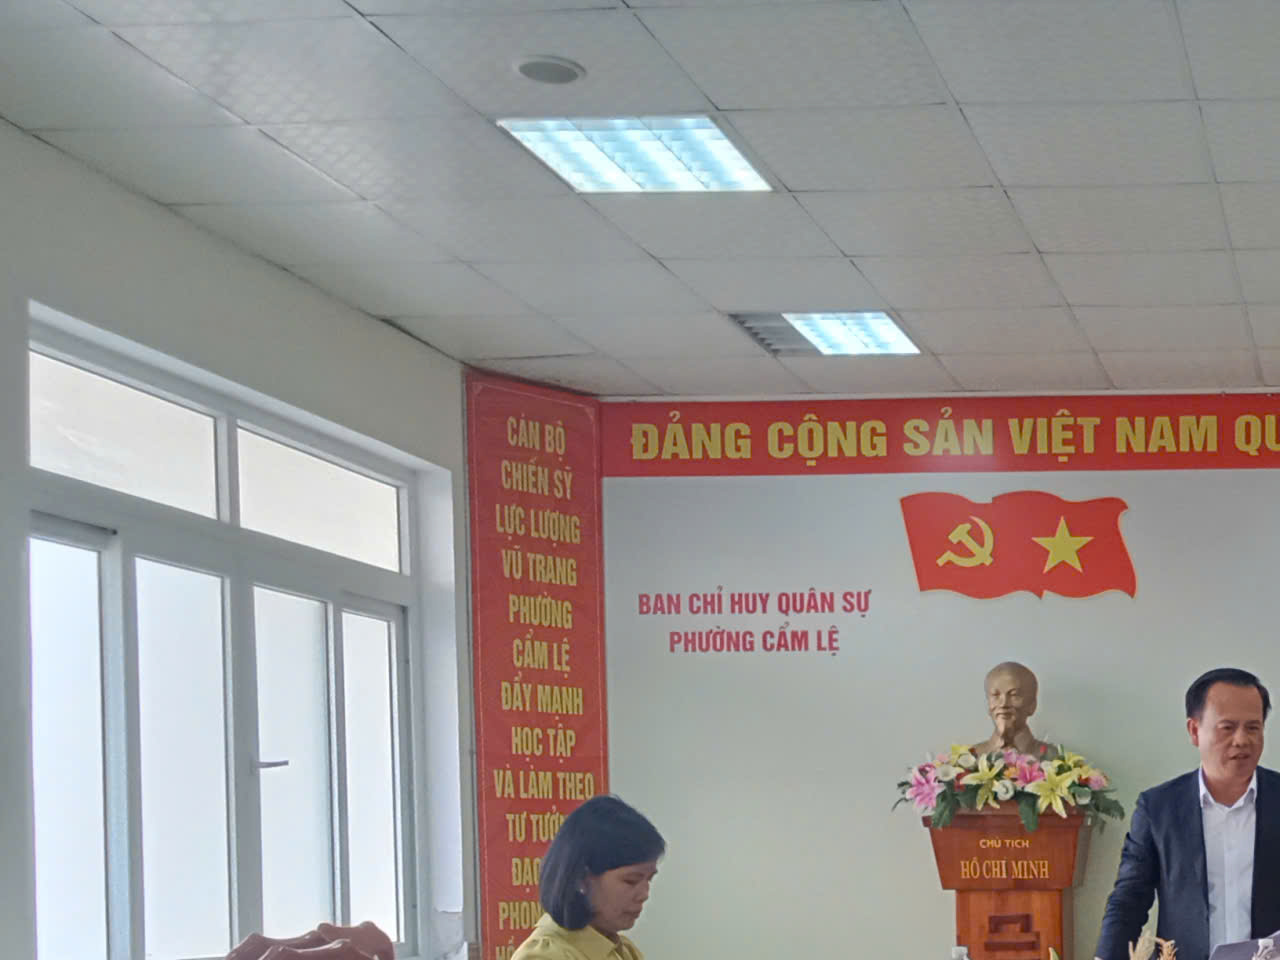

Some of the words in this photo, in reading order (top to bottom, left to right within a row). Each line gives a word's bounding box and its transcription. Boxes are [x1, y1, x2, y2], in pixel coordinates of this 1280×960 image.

[545, 419, 567, 463] BỘ
[631, 411, 752, 460] ĐẢNG
[767, 414, 889, 467] CỘNG
[903, 407, 994, 457] SẢN
[1008, 409, 1101, 463] VIỆT
[1115, 415, 1219, 454] NAM
[501, 455, 550, 497] CHIẾN
[496, 503, 526, 541] LỰC
[530, 507, 581, 548] LƯỢNG
[501, 544, 522, 580] VŨ
[527, 551, 578, 587] TRANG
[508, 591, 573, 630] PHƯỜNG
[638, 592, 681, 616] BAN
[688, 585, 724, 616] CHỈ
[729, 592, 770, 616] HUY
[777, 588, 836, 616] QUÂN
[841, 588, 873, 617] SỰ
[513, 629, 549, 669] CẨM
[553, 637, 571, 678] LỆ
[669, 627, 756, 654] PHƯỜNG
[761, 622, 811, 653] CẨM
[816, 629, 840, 657] LỆ
[501, 671, 532, 712] ĐẨY
[537, 684, 584, 721] MẠNH
[511, 725, 543, 763] HỌC
[547, 722, 577, 764] TẬP
[493, 763, 515, 799] VÀ
[519, 763, 553, 800] LÀM
[556, 772, 595, 800] THEO
[505, 811, 528, 843] TƯ
[530, 804, 567, 843] TƯỞ
[1011, 860, 1049, 879] MINH
[498, 900, 544, 931] PHON
